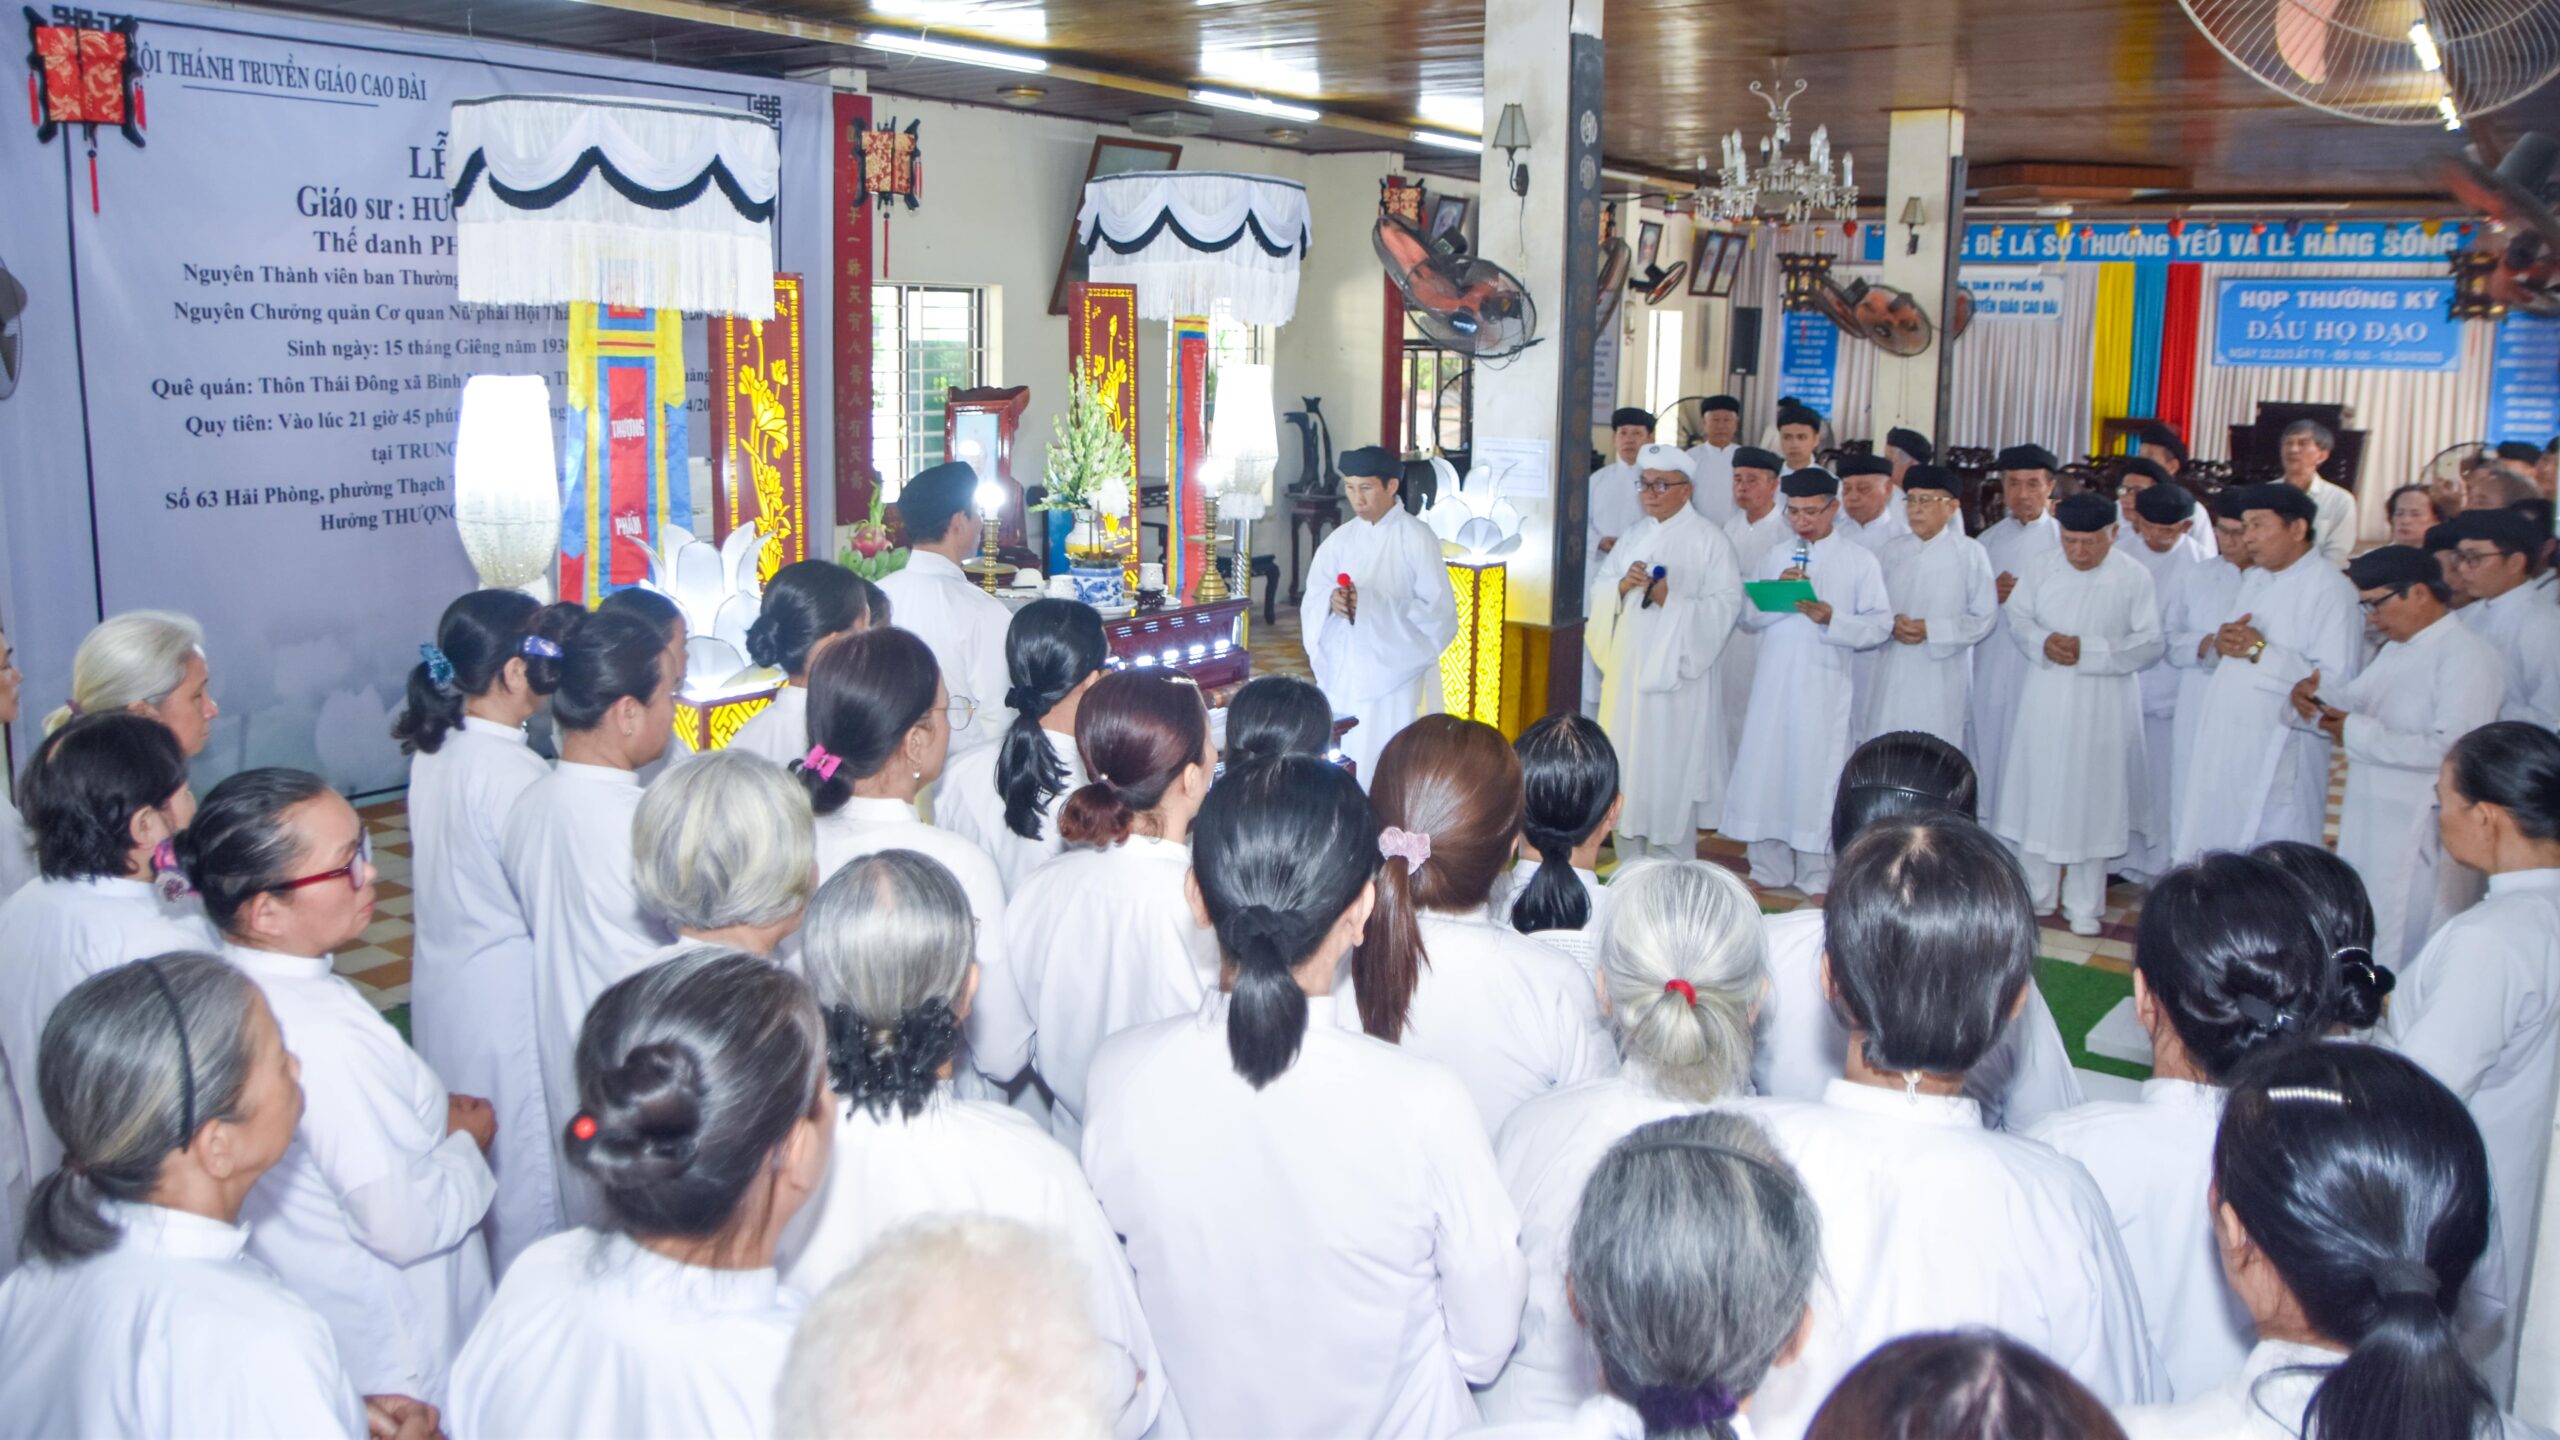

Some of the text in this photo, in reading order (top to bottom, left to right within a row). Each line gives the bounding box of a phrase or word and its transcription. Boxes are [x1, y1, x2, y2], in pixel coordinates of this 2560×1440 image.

[141, 41, 427, 101] ỘI THÁNH TRUYỀN GIÁO CAO ĐÀI
[297, 185, 357, 220] Giáo
[366, 197, 393, 221] sư
[314, 226, 357, 254] Thế
[366, 234, 422, 256] danh
[183, 263, 254, 287] Nguyên
[260, 265, 318, 284] Thành
[325, 266, 358, 285] viên
[364, 268, 394, 285] ban
[174, 302, 244, 324] Nguyên
[250, 302, 322, 324] Chưởng
[328, 303, 370, 325] quản
[376, 303, 400, 321] Cơ
[406, 307, 444, 324] quan
[2240, 290, 2290, 312] HỌP
[2314, 321, 2357, 346] HỌ
[2364, 321, 2429, 347] ĐẠO
[287, 338, 569, 360] Sinh ngày: 15 tháng Giêng năm 193
[151, 378, 194, 398] Quê
[200, 377, 253, 400] quán:
[259, 376, 305, 394] Thôn
[310, 376, 350, 393] Thái
[355, 374, 399, 393] Đông
[404, 375, 421, 390] xã
[186, 415, 226, 437] Quy
[278, 412, 313, 431] Vào
[319, 411, 343, 429] lúc
[348, 411, 366, 427] 21
[372, 410, 398, 429] giờ
[402, 408, 421, 424] 45
[371, 446, 392, 465] tại
[165, 485, 190, 510] Số
[196, 490, 218, 508] 63
[225, 489, 258, 507] Hải
[330, 480, 393, 503] phường
[396, 475, 445, 498] Thạch
[320, 512, 378, 533] Hưởng
